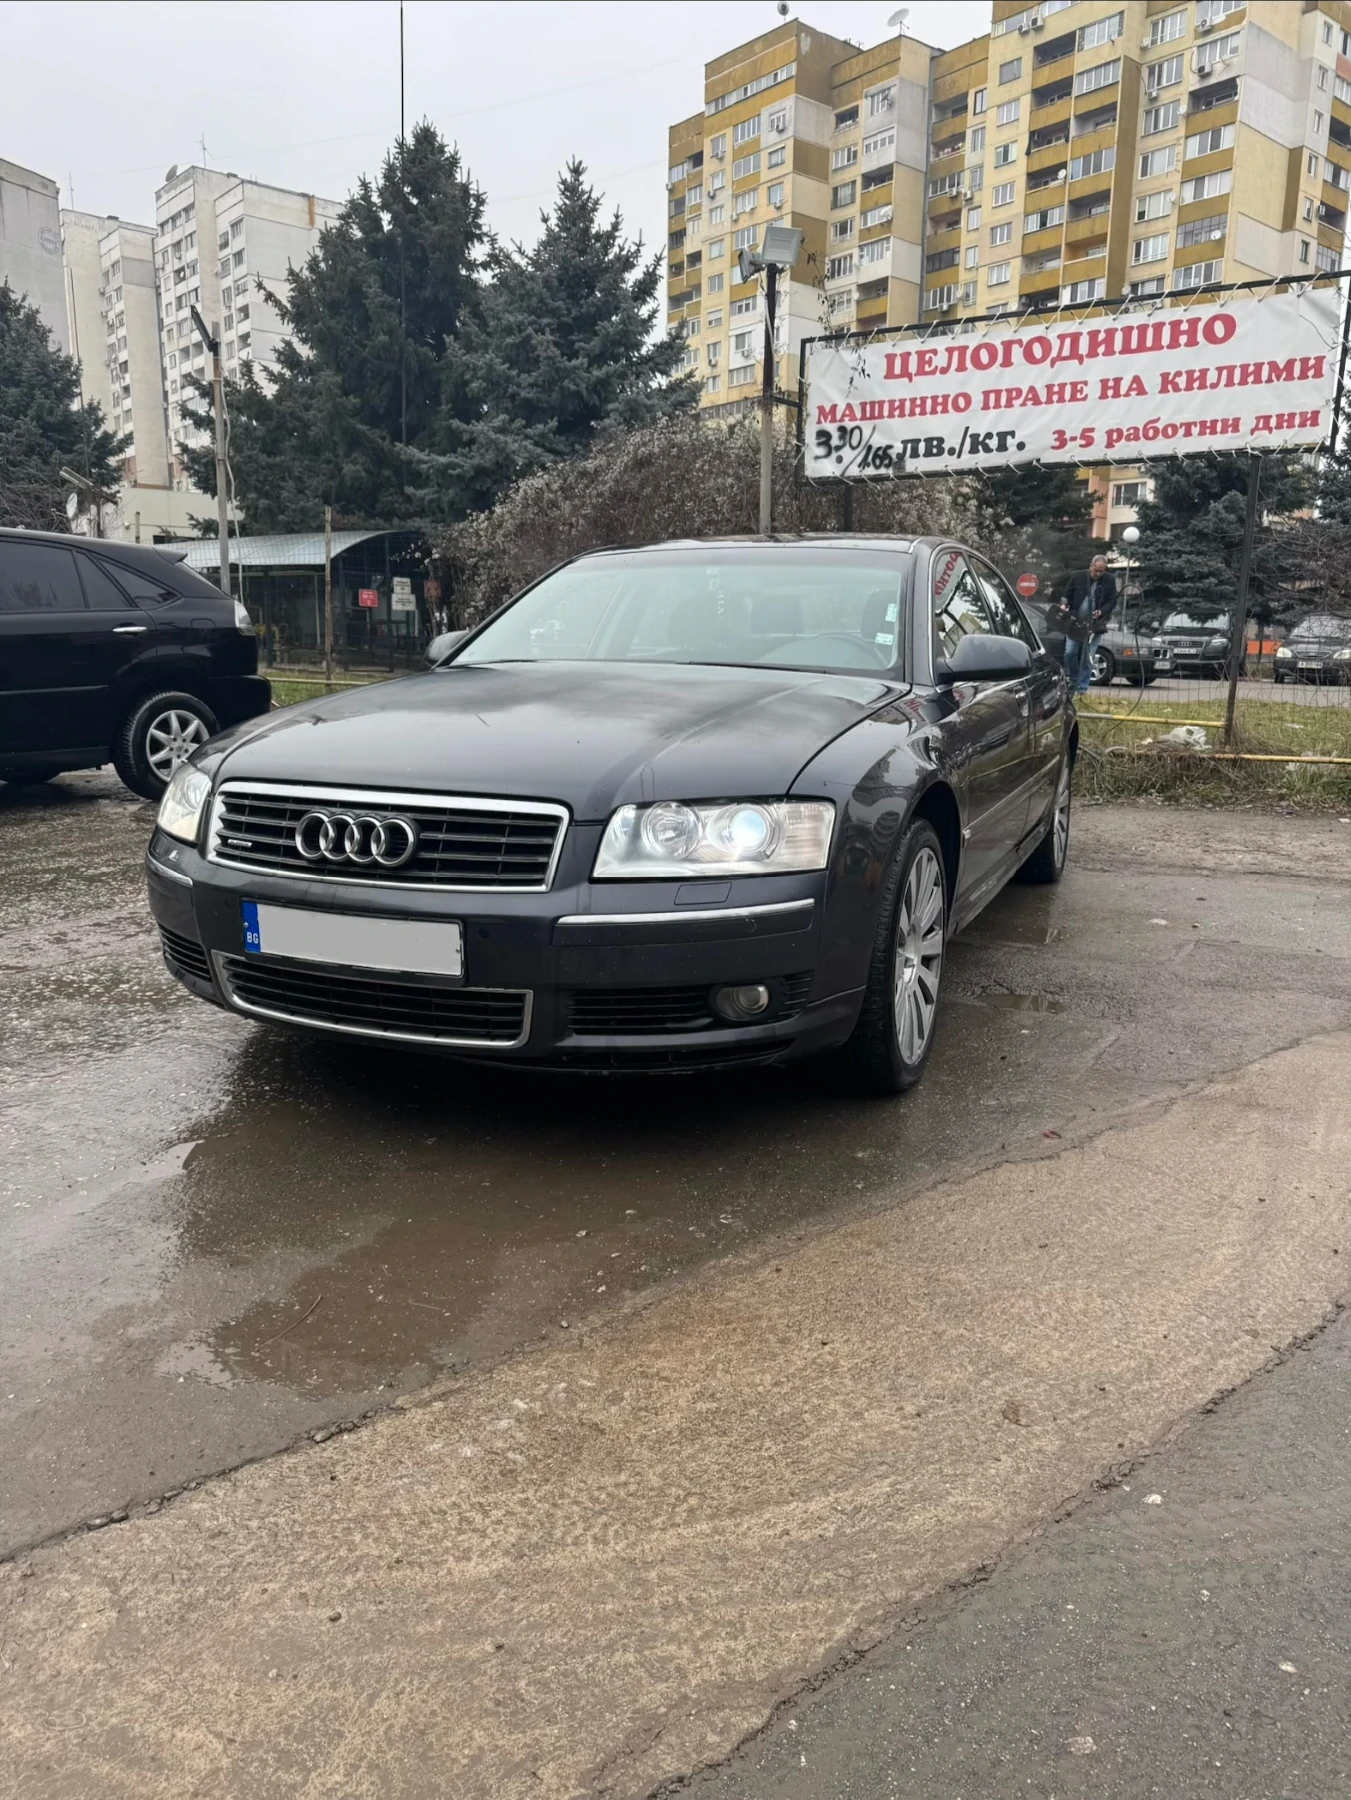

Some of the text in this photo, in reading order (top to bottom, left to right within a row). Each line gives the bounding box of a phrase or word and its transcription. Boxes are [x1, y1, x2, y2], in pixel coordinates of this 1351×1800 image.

[883, 313, 1237, 383] ЦЕЛОГОДИШНО
[816, 355, 1327, 425] МАШИННО ПРАНЕ НА КИЛИМИ
[895, 425, 1026, 460] лв./кг.
[1051, 409, 1322, 450] 3-5 работни дни
[246, 931, 259, 944] BG
